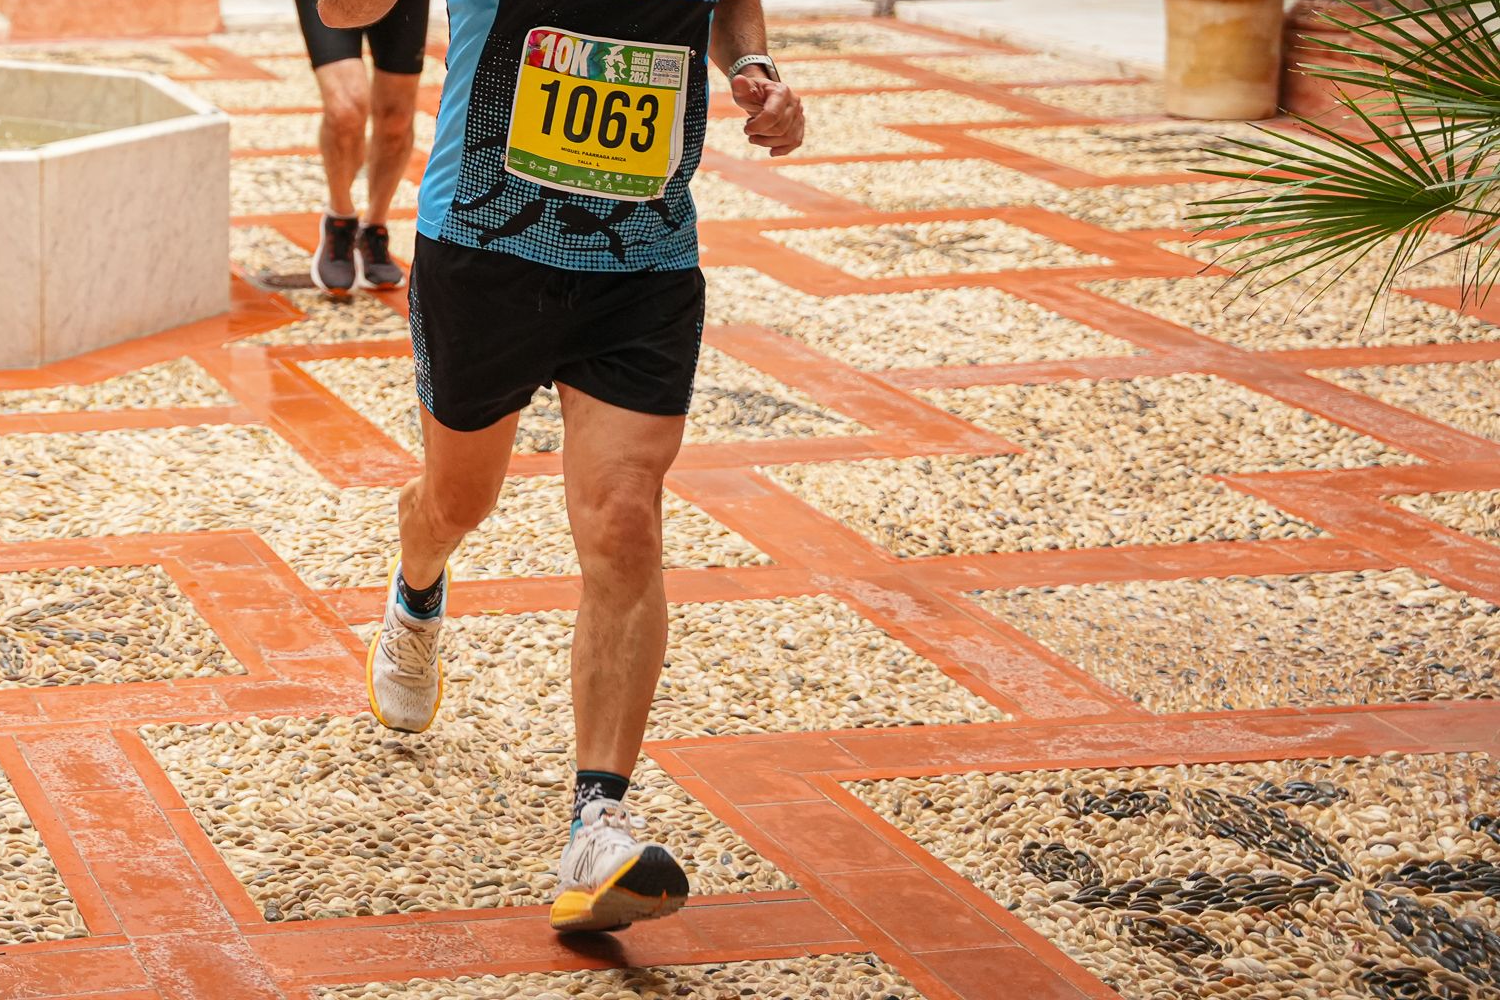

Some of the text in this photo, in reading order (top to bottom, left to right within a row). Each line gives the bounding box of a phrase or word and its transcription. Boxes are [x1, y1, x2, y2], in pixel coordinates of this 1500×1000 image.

[540, 34, 594, 78] 10K
[629, 72, 649, 84] 2026
[540, 79, 659, 153] 1063
[561, 146, 580, 155] MIGUEL
